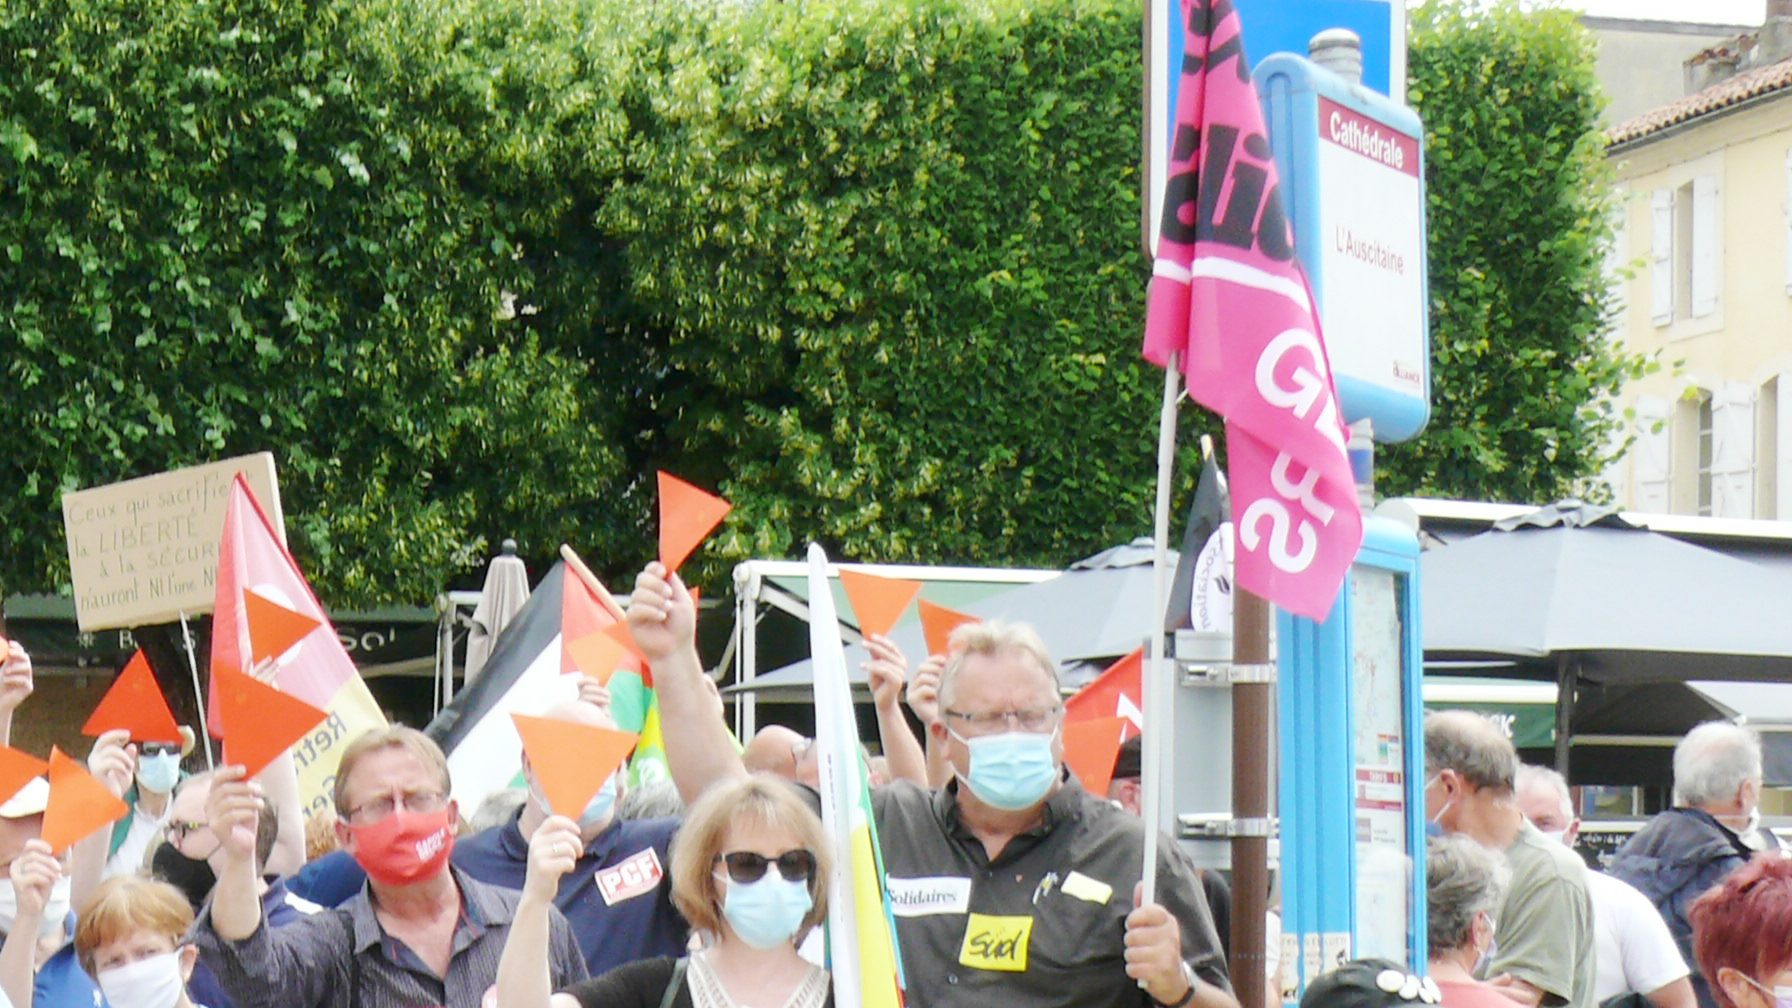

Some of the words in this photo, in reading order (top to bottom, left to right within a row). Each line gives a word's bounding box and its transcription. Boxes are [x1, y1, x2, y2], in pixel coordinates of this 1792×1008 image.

[1329, 110, 1404, 170] Cathédrale
[1335, 224, 1404, 275] L'Auscitaine
[68, 500, 116, 526] Ceux
[126, 496, 150, 526] qui
[74, 536, 88, 559] la
[99, 506, 200, 554] LIBERTÉ
[119, 554, 135, 574] la
[601, 853, 656, 894] PCF
[889, 887, 957, 906] Solidaires
